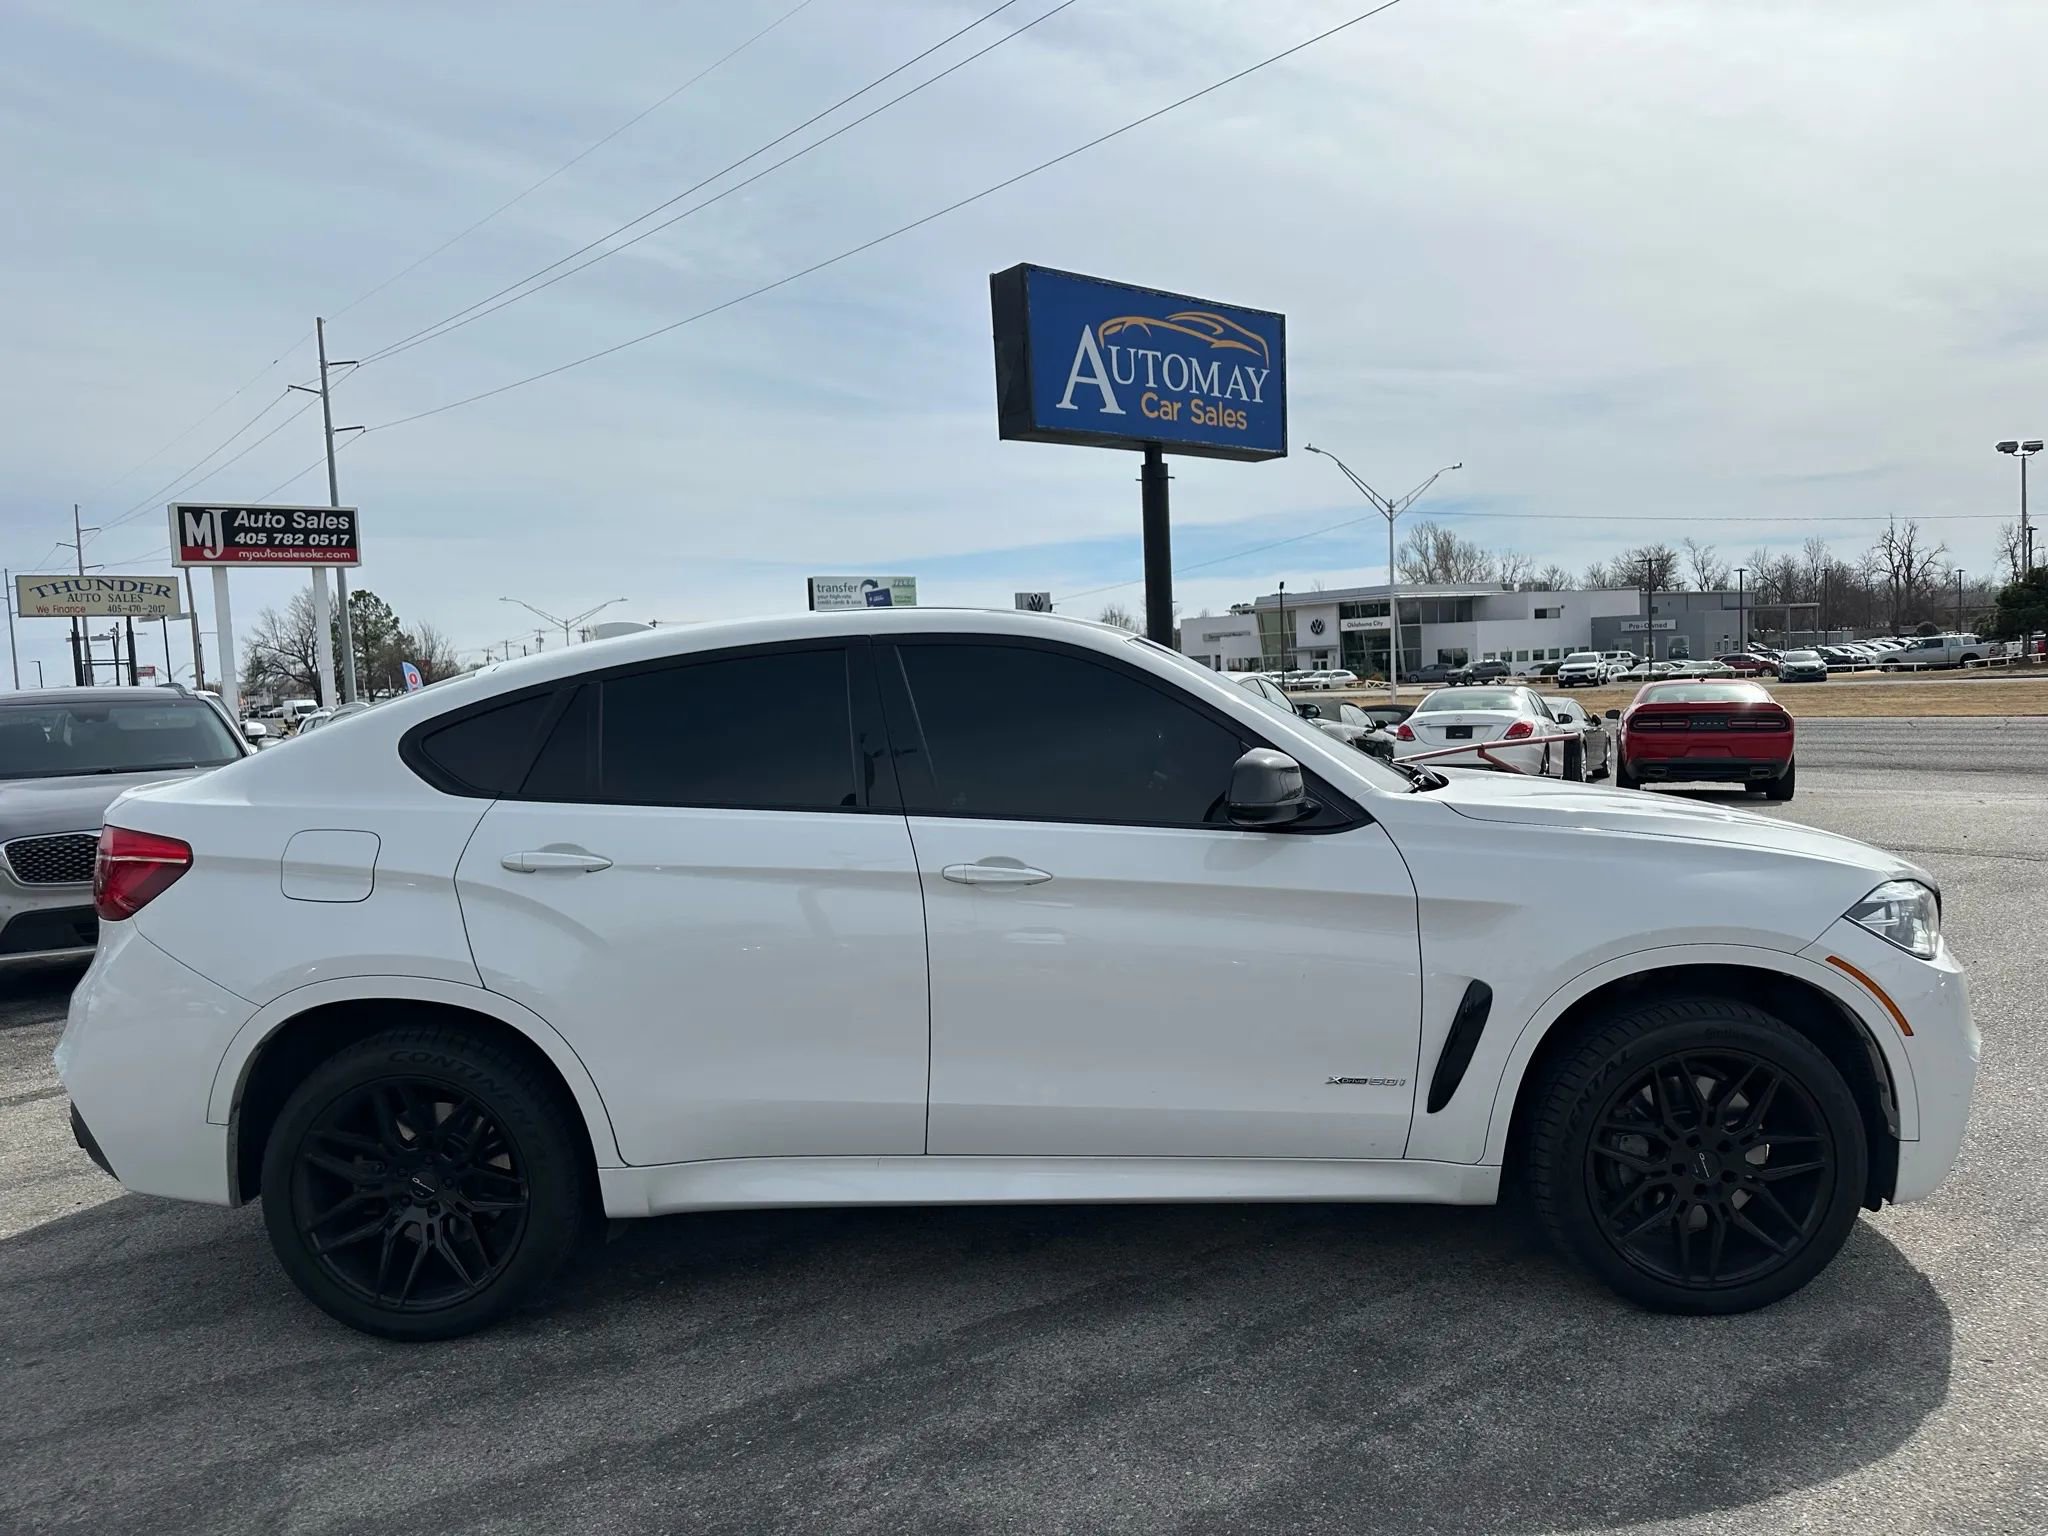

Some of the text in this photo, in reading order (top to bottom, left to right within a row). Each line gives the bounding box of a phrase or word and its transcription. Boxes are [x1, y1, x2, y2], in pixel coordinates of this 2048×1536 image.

[1055, 324, 1271, 415] AUTOMAY
[1140, 392, 1248, 430] Car Sales
[234, 510, 350, 529] Auto Sales
[184, 509, 228, 559] MJ
[235, 532, 350, 546] 405 782 0517
[238, 549, 350, 560] mjautosalesokc.com
[29, 579, 172, 599] THUNDER
[816, 582, 858, 593] transfer
[67, 593, 144, 603] AUTO SALES
[36, 605, 86, 614] We Finance
[107, 605, 166, 614] 405-470-2017
